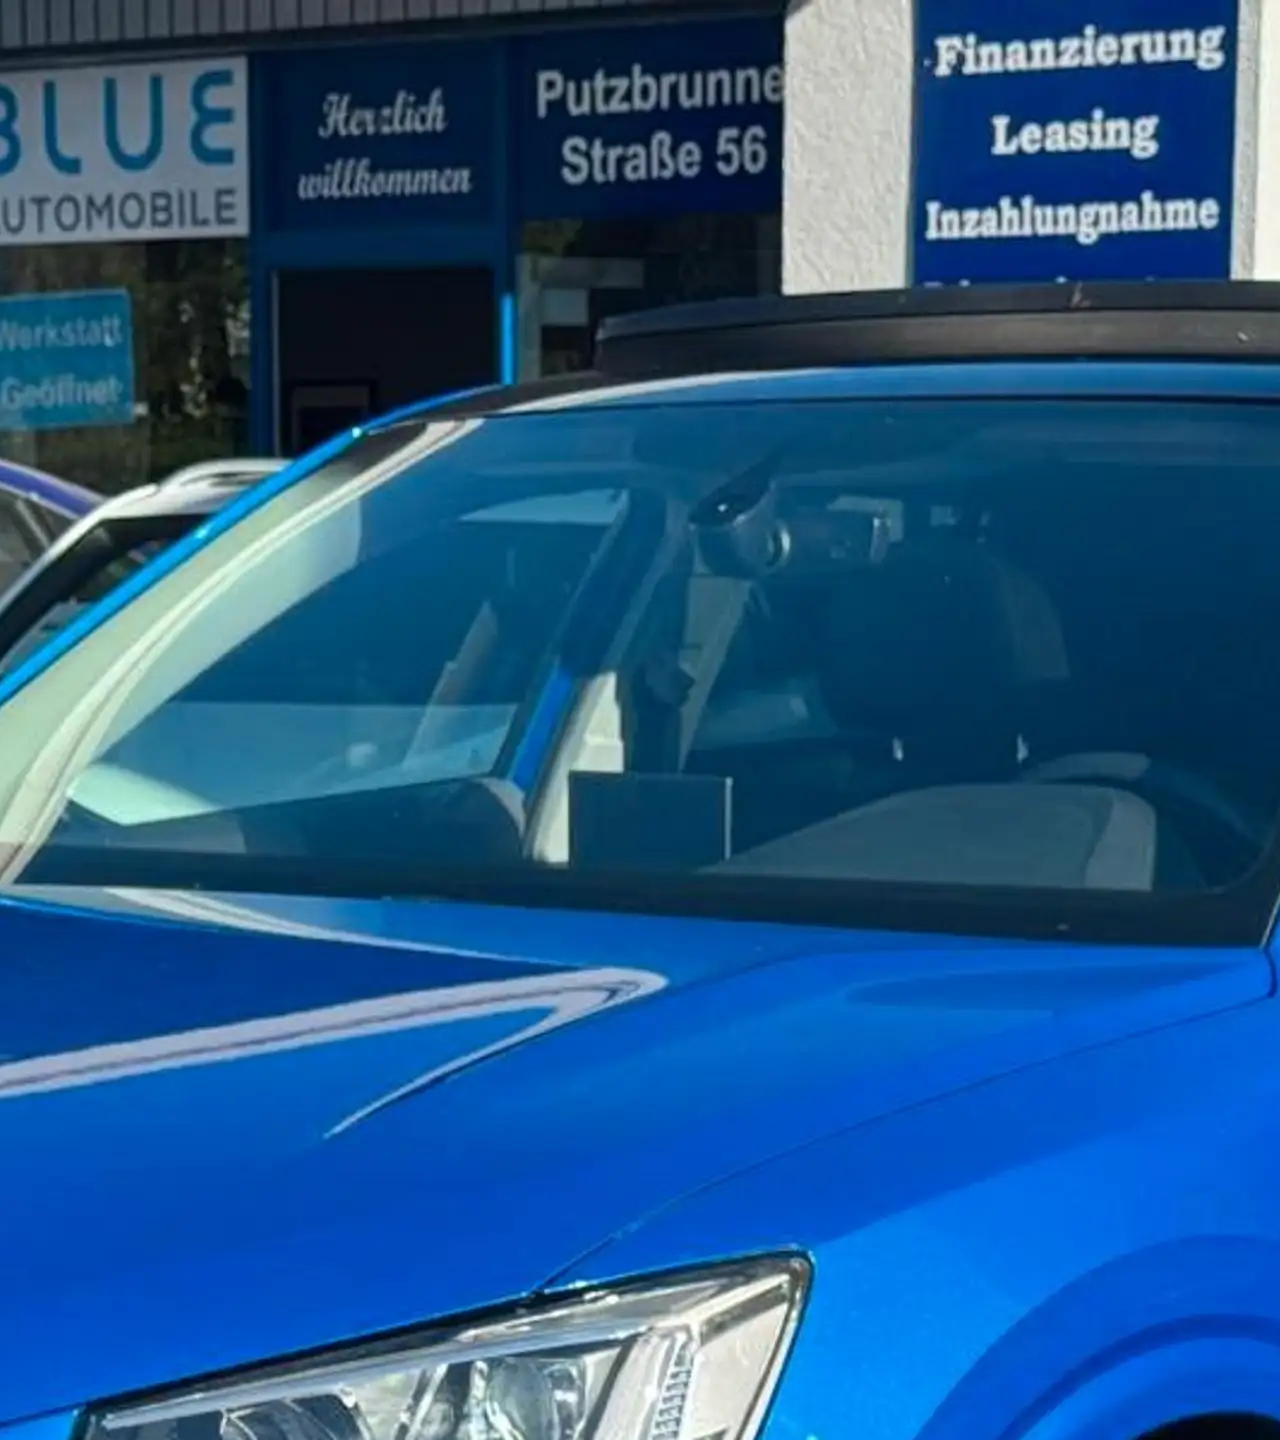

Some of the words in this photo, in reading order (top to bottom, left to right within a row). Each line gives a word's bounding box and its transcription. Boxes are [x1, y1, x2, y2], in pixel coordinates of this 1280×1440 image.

[934, 24, 1226, 78] Finanzierung
[318, 88, 448, 140] Herzlich
[536, 62, 783, 119] Putzbrunne
[561, 132, 703, 185] Straße
[715, 126, 767, 177] 56
[990, 107, 1160, 160] Leasing
[298, 157, 473, 200] willkommen
[925, 190, 1220, 244] Inzahlungnahme
[0, 370, 123, 409] Geöffnet
